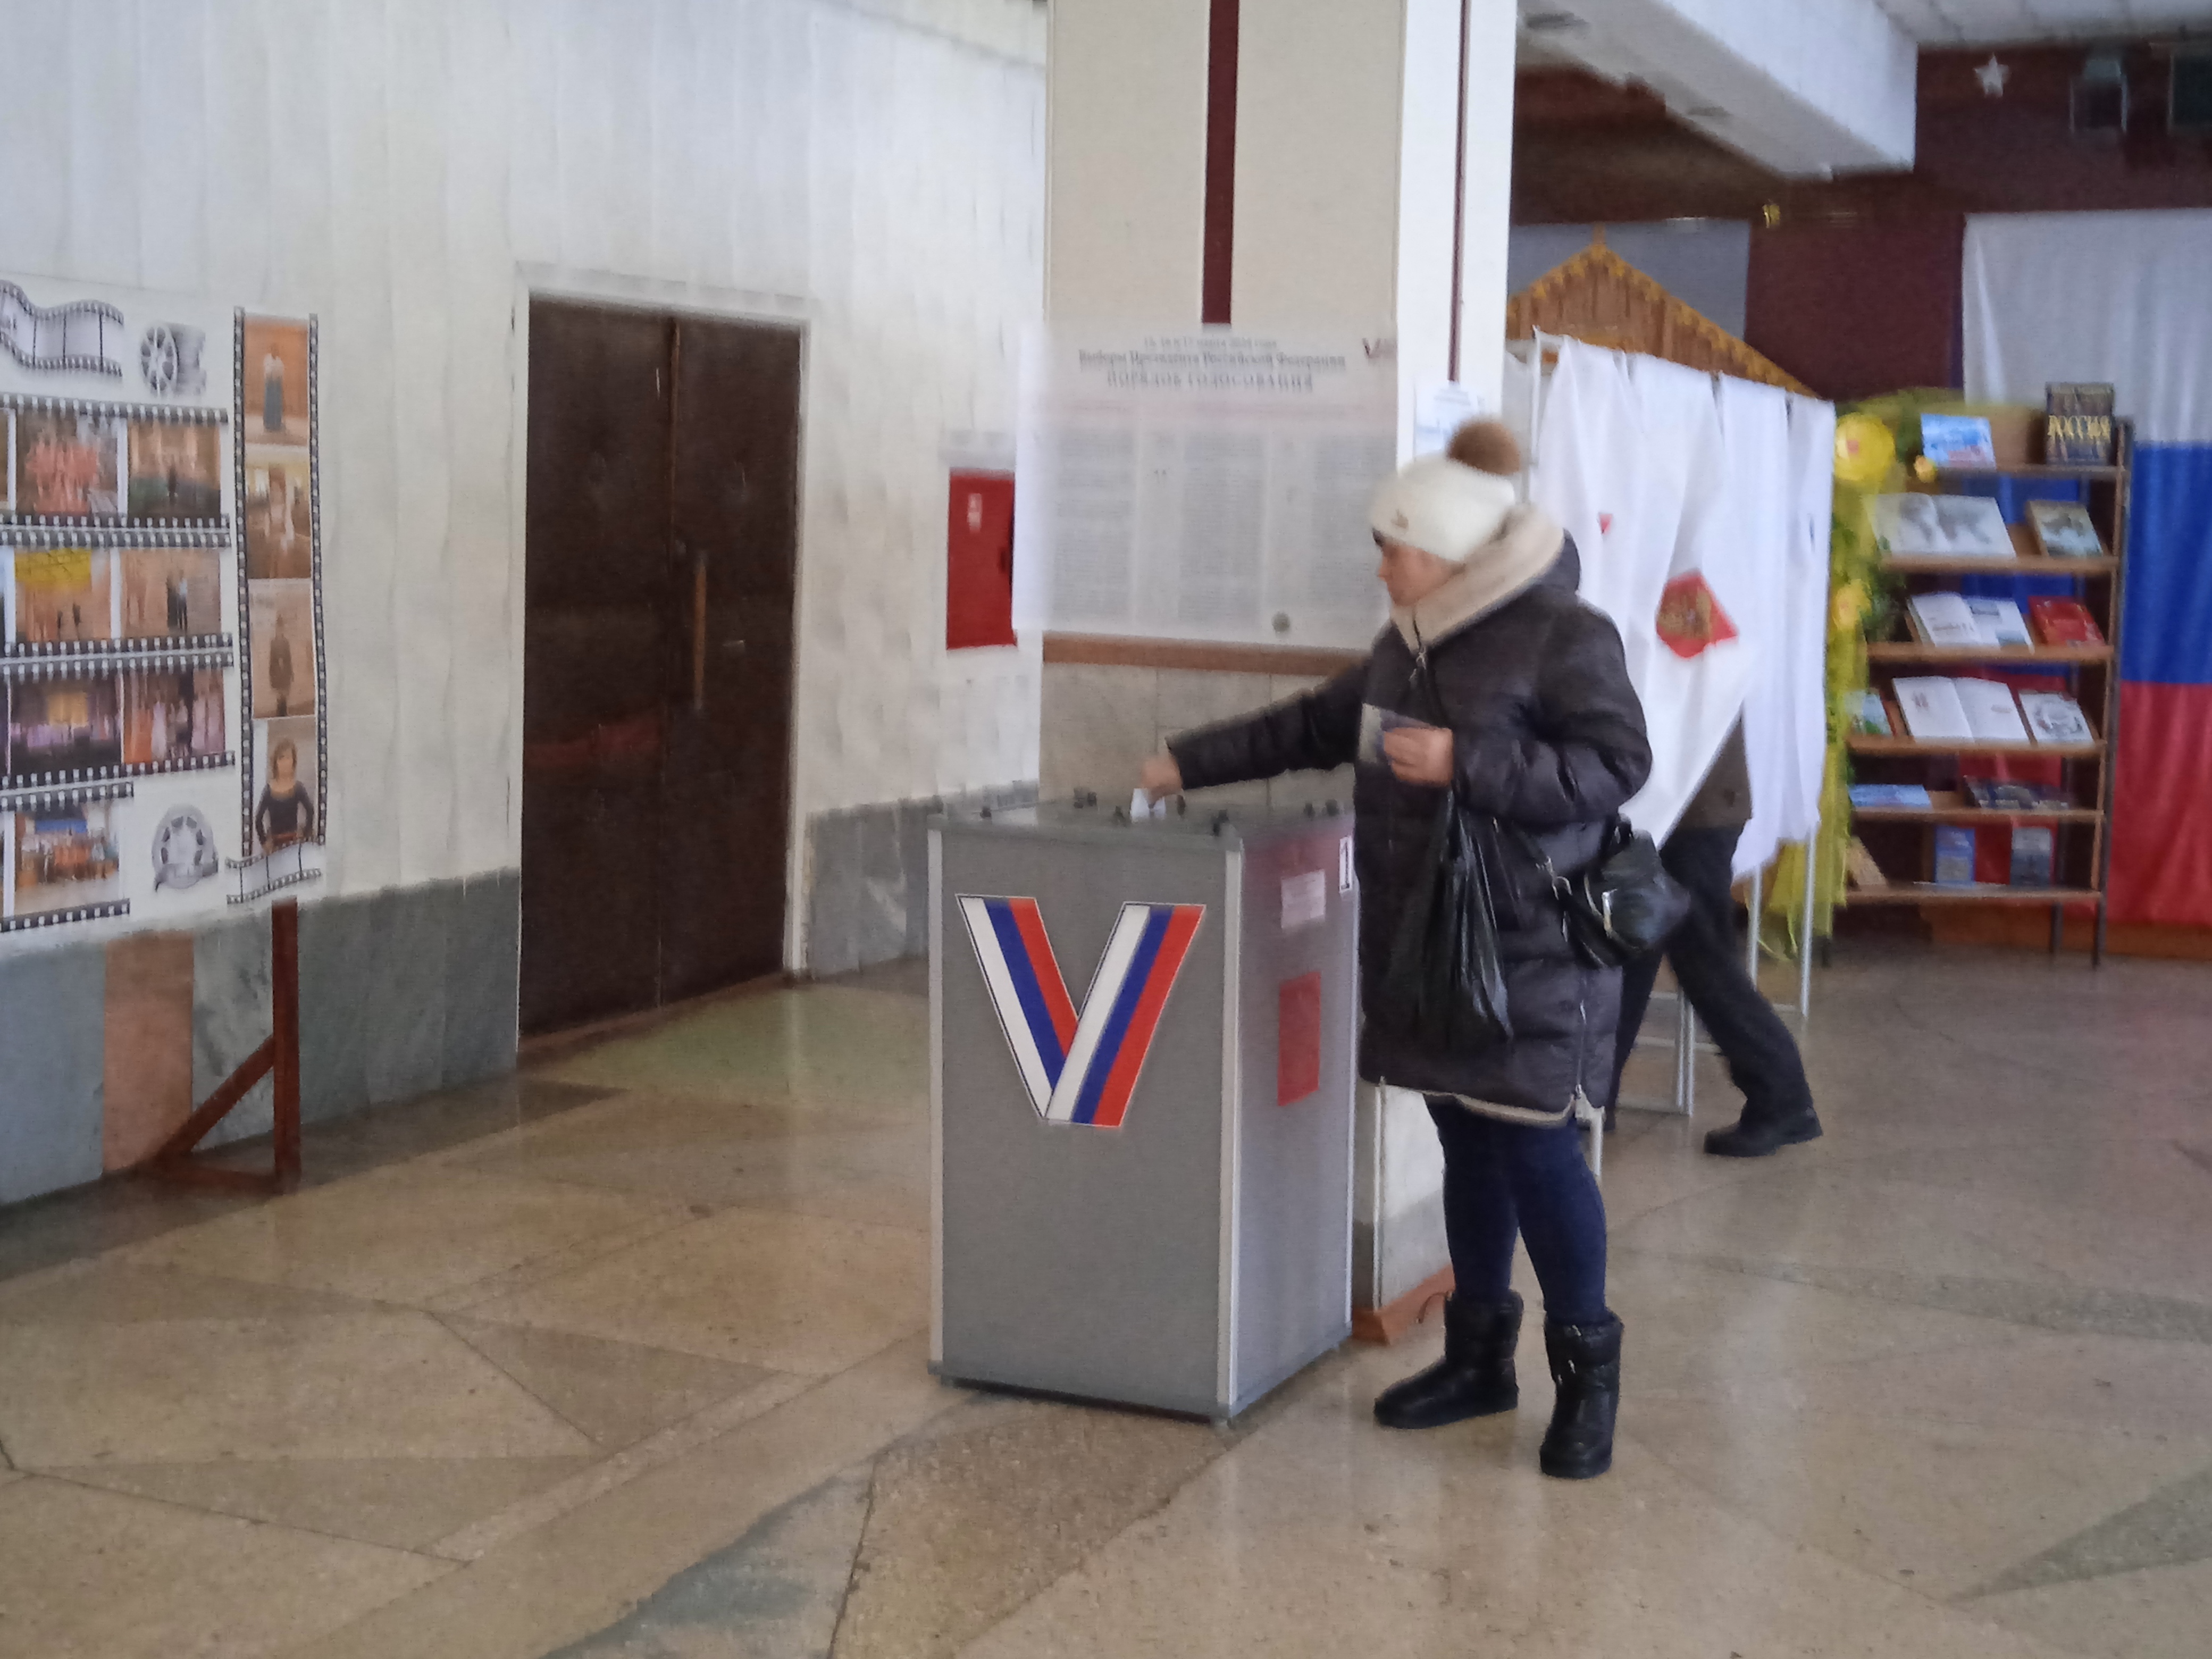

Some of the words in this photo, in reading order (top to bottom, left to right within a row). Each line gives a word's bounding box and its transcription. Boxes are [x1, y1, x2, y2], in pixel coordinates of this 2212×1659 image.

[1079, 349, 1126, 368] Выборы
[1129, 350, 1199, 367] Президента
[1202, 351, 1273, 368] Российской
[1277, 352, 1346, 370] Федерации
[1107, 371, 1182, 389] ПОРЯДОК
[1187, 372, 1313, 392] ГОЛОСОВАНИЯ
[2048, 415, 2112, 442] РОССИЯ
